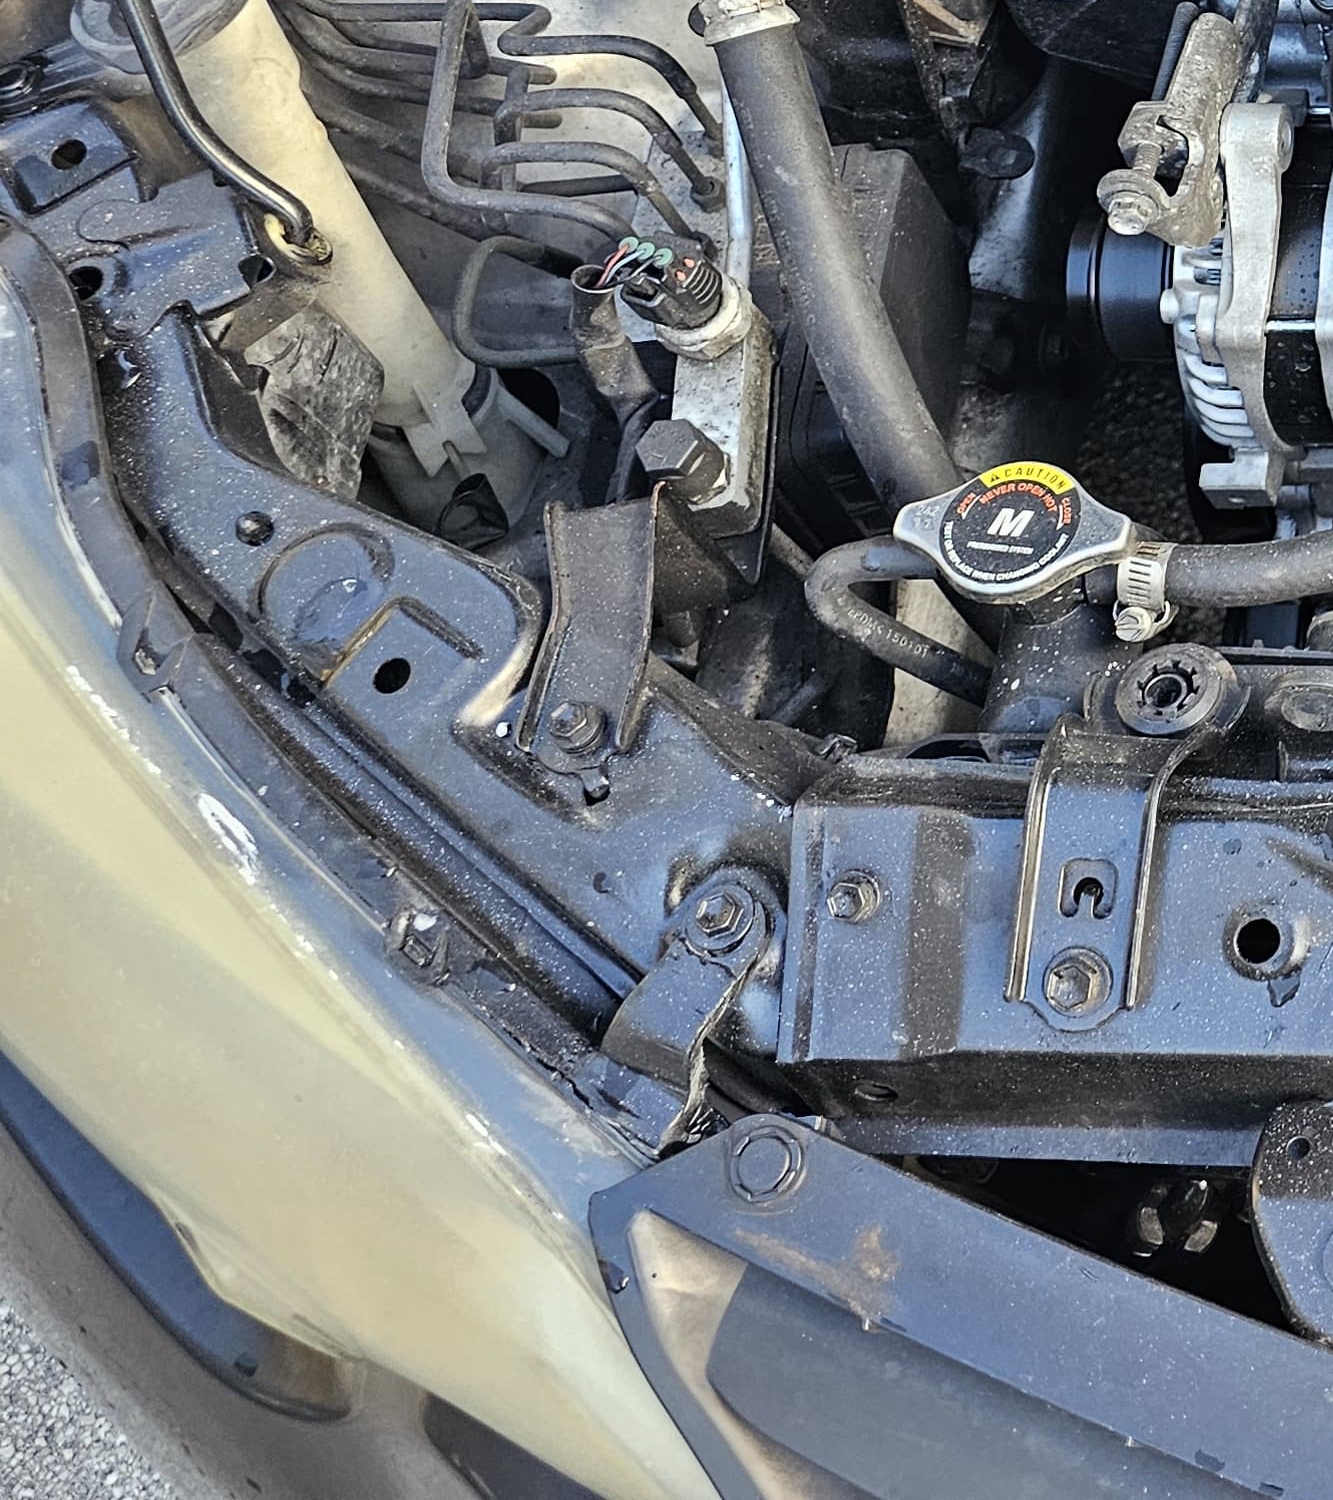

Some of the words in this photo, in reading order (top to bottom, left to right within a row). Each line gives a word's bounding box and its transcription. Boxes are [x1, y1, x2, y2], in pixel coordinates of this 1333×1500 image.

[1004, 467, 1066, 490] CAUTION
[979, 482, 1016, 505] NEVER
[1016, 482, 1045, 498] OPEN
[1041, 489, 1058, 512] HOT
[986, 507, 1035, 537] M
